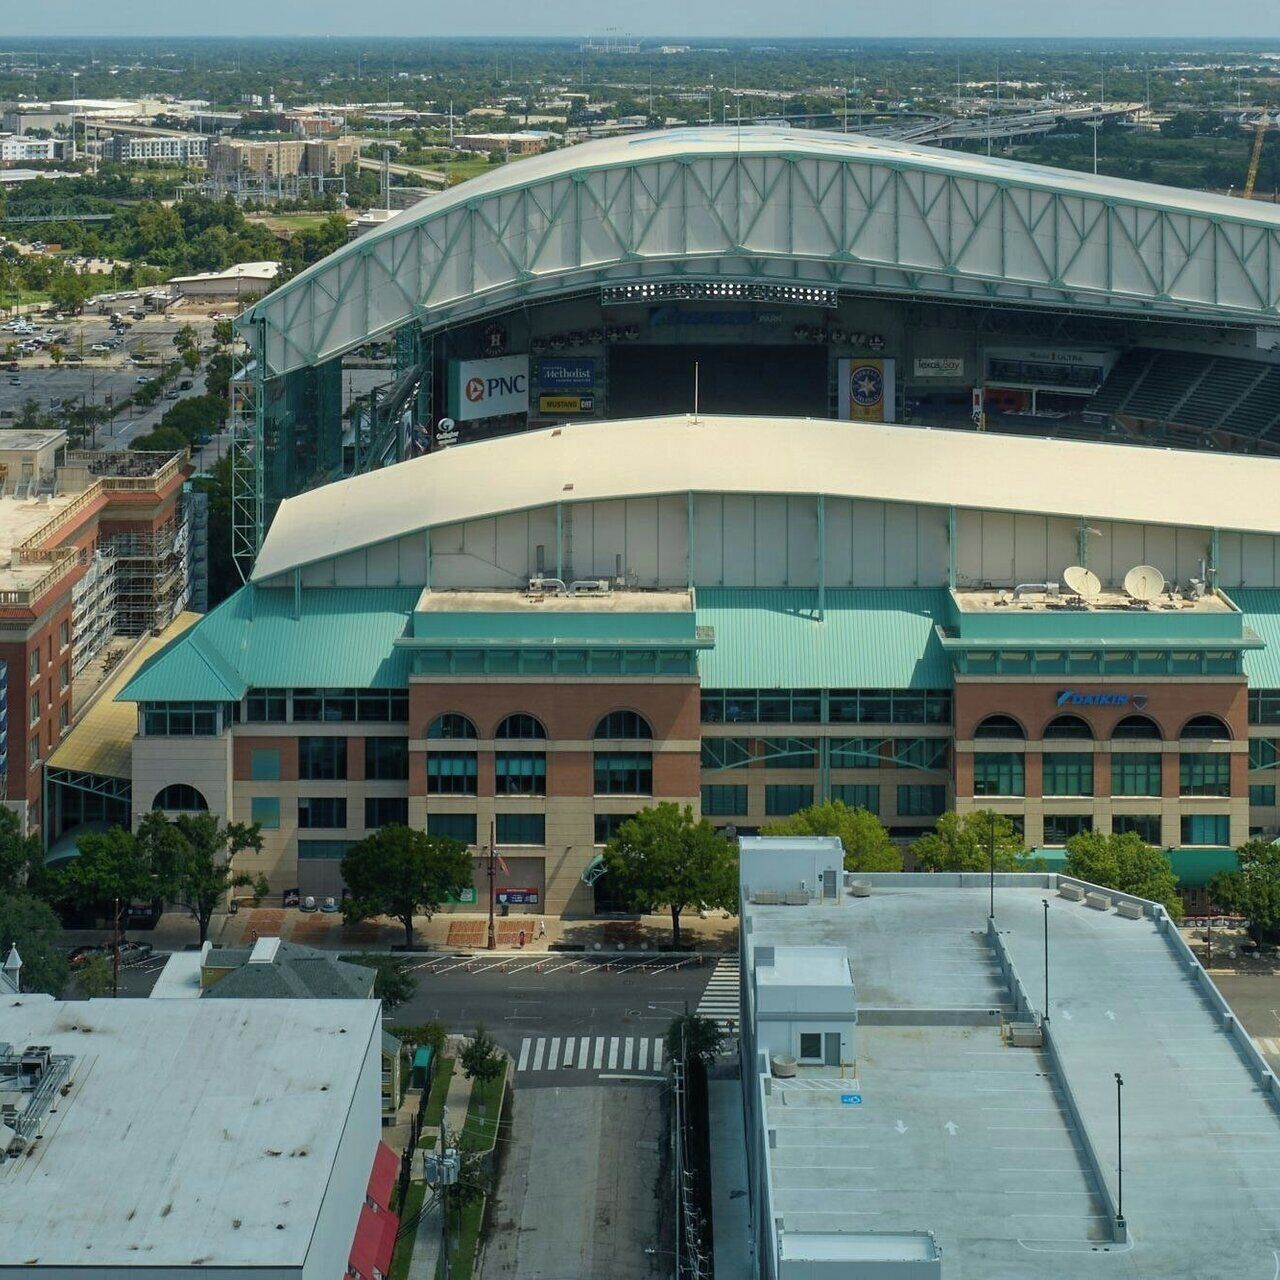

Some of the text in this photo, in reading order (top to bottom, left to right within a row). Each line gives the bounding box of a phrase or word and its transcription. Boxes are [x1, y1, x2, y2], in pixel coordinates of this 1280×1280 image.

[544, 368, 591, 379] Methodist
[487, 375, 526, 398] PNC
[546, 399, 578, 408] MUSTANG
[1072, 694, 1129, 705] DAIKIN
